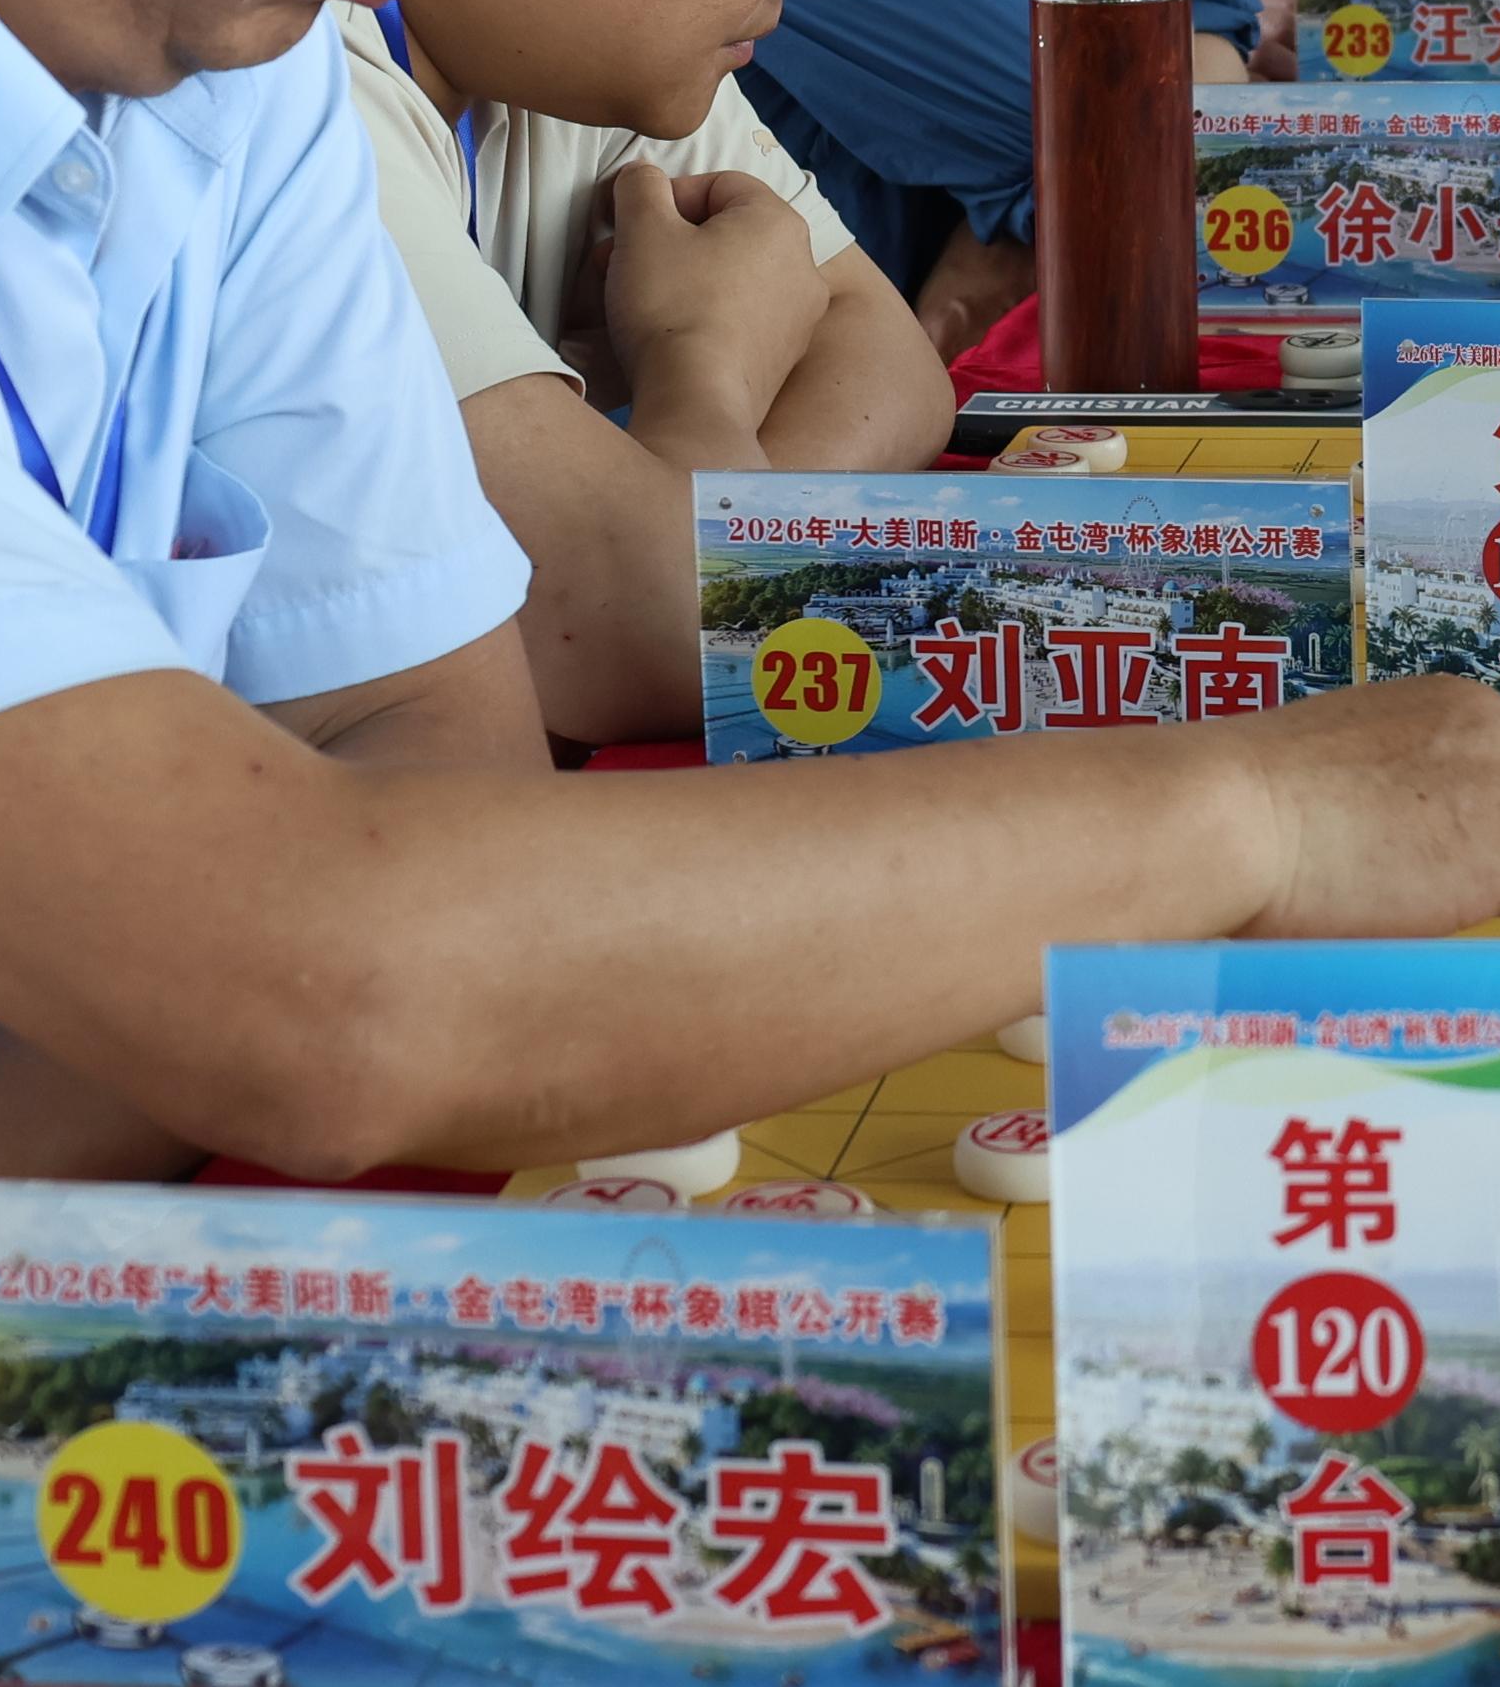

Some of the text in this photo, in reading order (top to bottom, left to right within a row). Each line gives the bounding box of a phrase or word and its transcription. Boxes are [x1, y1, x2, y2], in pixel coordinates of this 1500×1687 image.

[1325, 22, 1391, 58] 233
[1206, 208, 1290, 253] 236
[994, 398, 1213, 411] CHRISTIAN
[762, 649, 872, 713] 237
[912, 622, 1290, 732] 刘亚南
[1265, 1118, 1408, 1587] 第 120 台
[49, 1470, 233, 1573] 240
[294, 1432, 893, 1625] 刘绘宏
